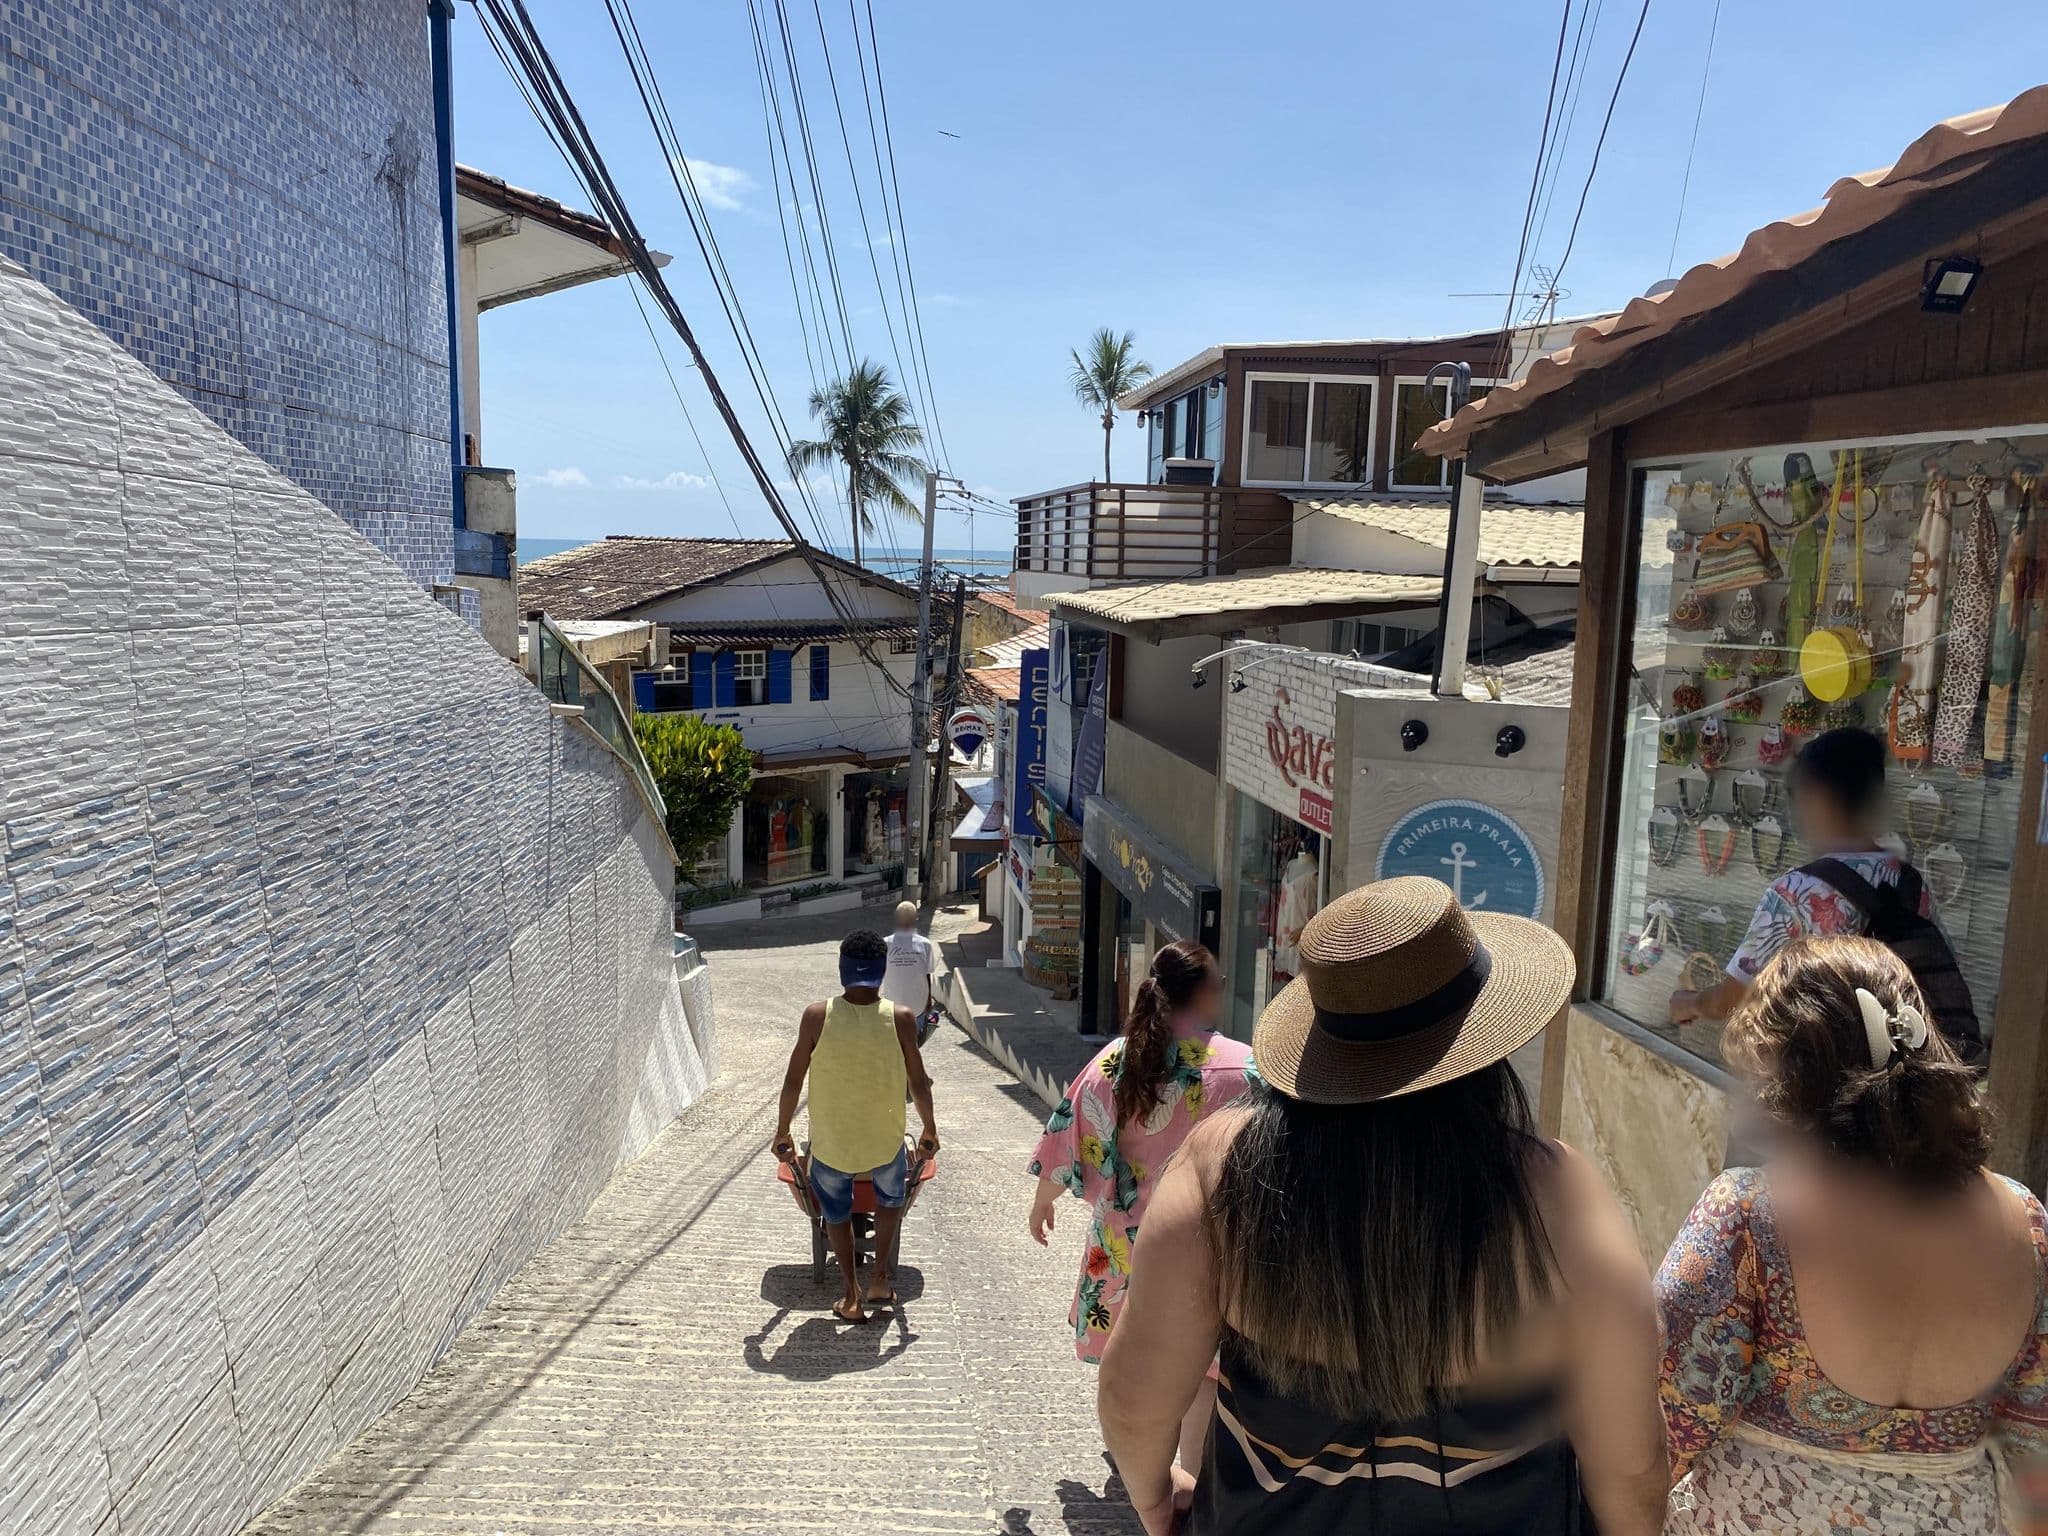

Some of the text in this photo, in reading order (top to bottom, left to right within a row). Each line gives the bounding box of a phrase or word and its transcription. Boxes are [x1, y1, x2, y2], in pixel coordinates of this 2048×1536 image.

[1300, 797, 1333, 827] OUTLET
[1396, 816, 1524, 869] PRIMEIRA PRAIA
